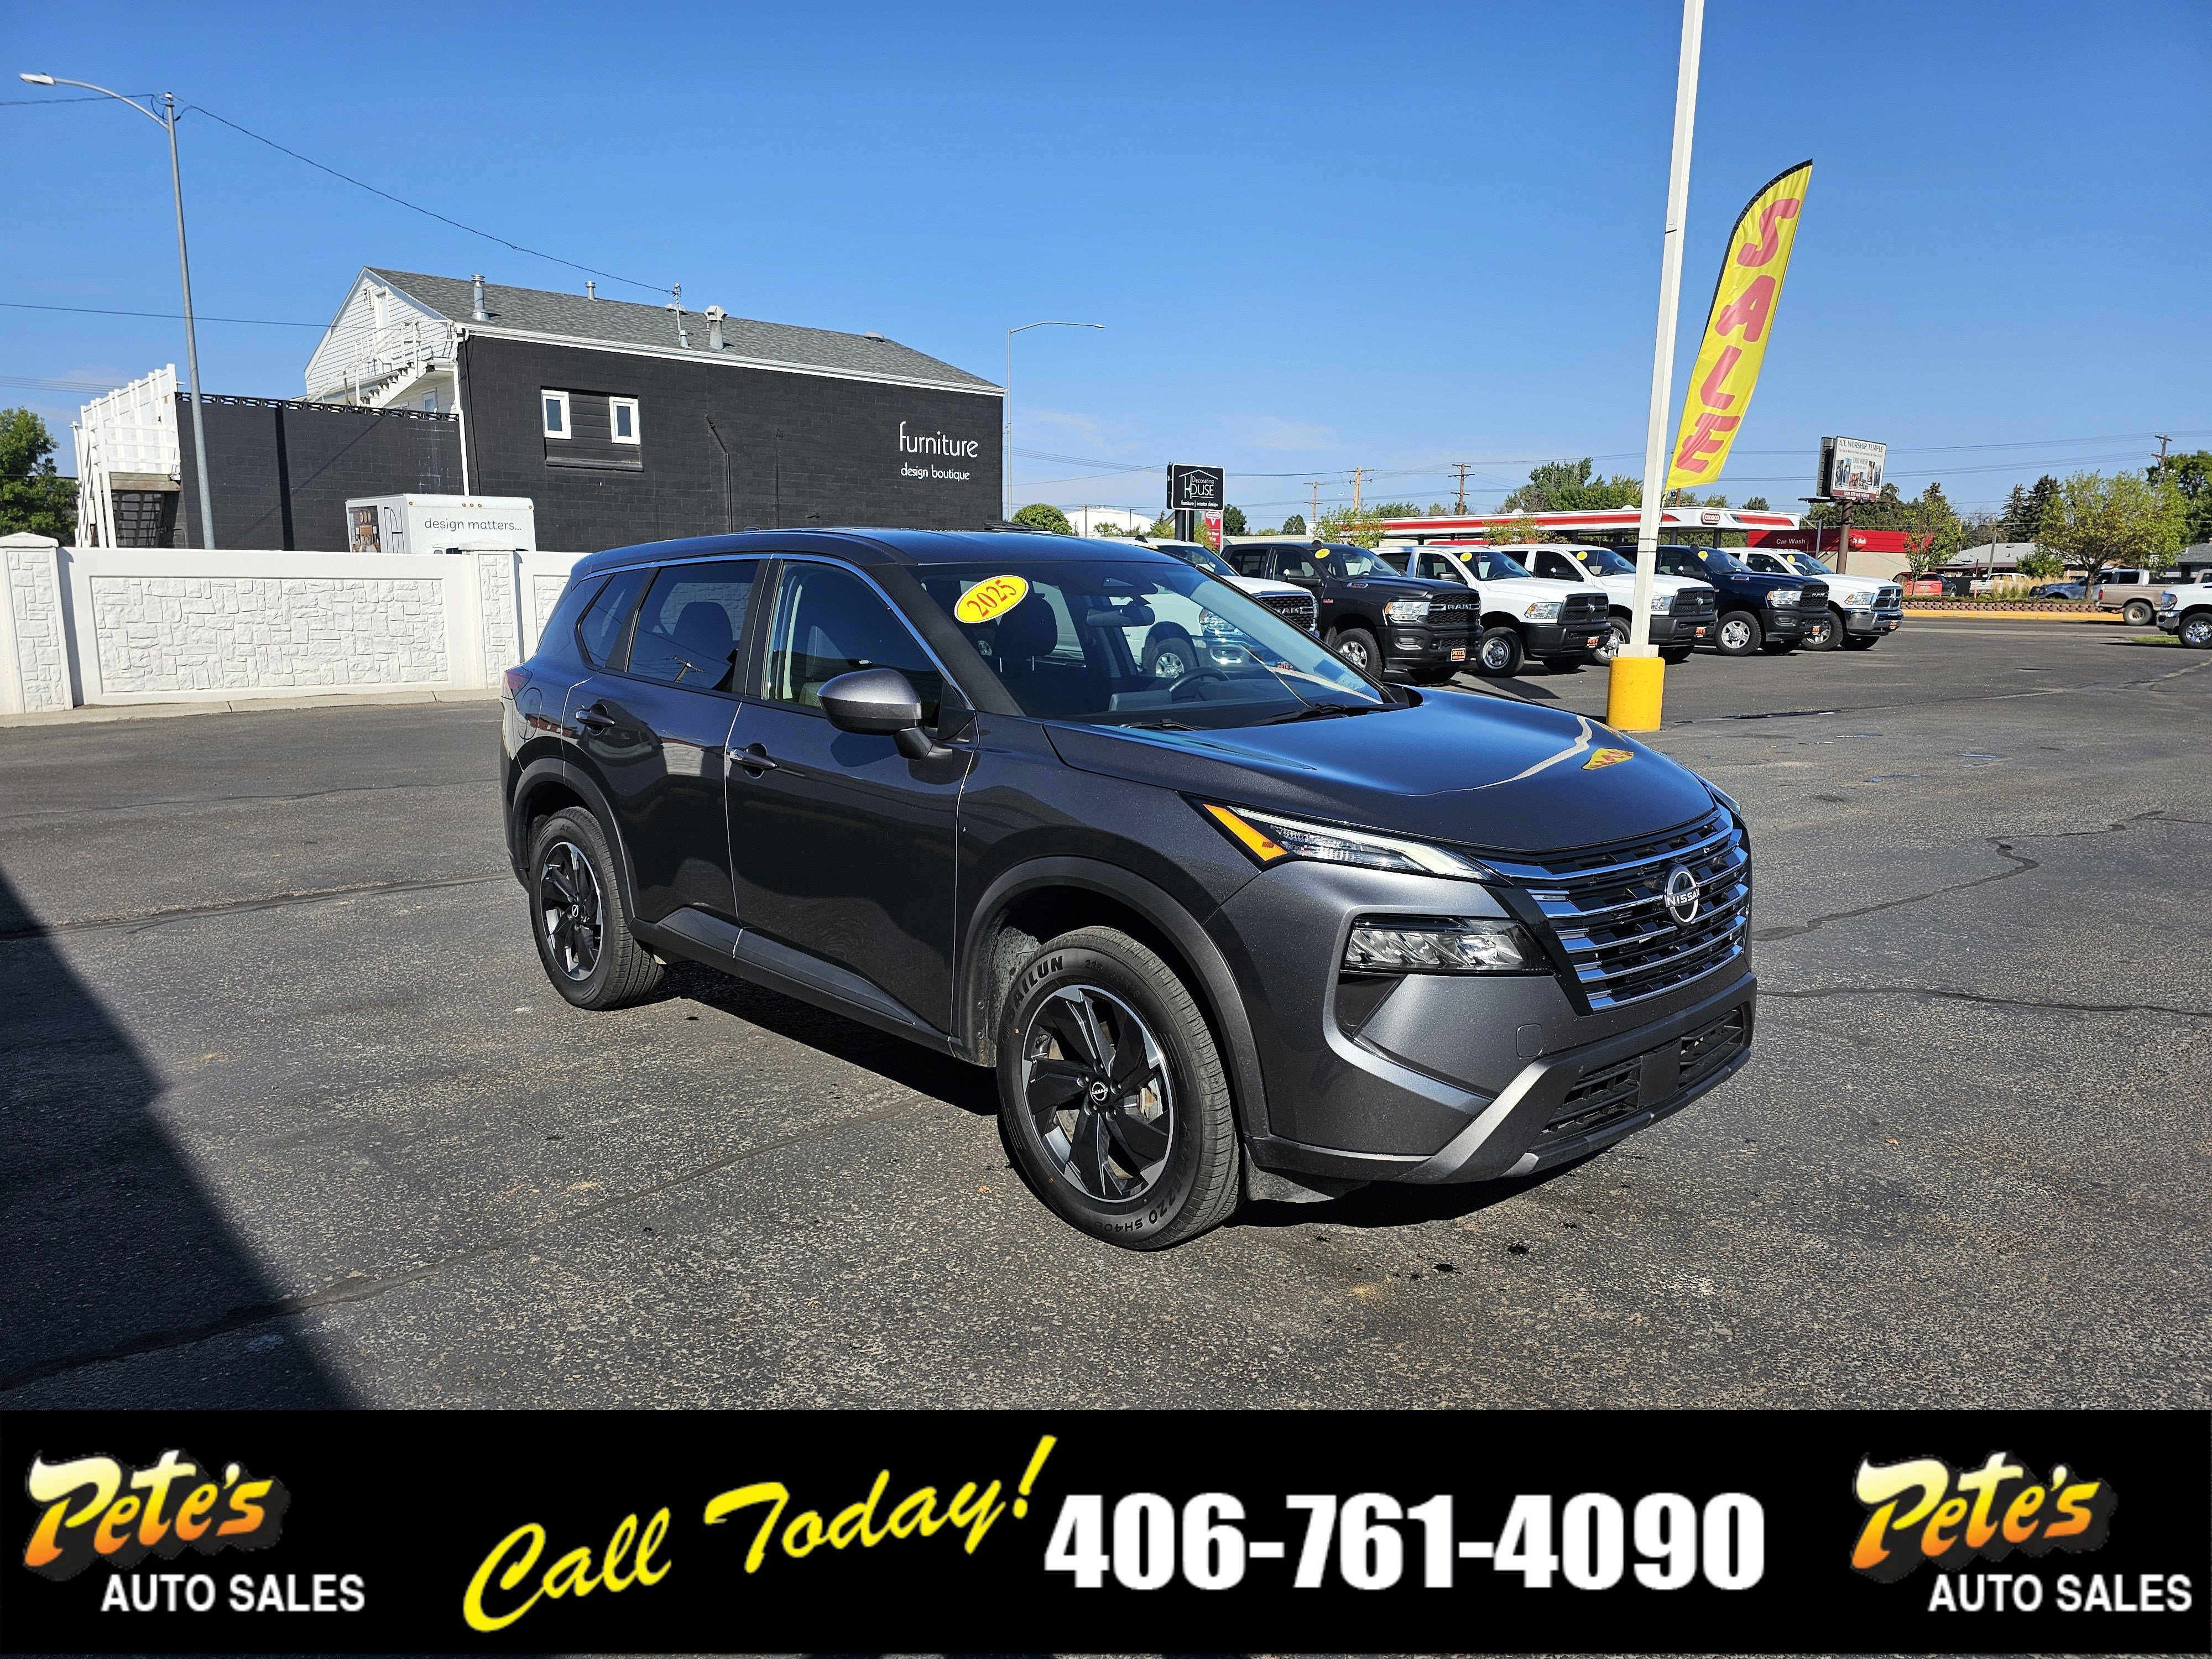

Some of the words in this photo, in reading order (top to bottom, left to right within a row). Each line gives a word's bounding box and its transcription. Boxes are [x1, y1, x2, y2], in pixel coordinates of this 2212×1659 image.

[1675, 197, 1799, 474] SALE
[900, 421, 979, 458] furniture
[1848, 441, 1867, 450] WORSHIP
[1868, 444, 1883, 452] TEMPLE
[900, 462, 928, 479] design
[931, 464, 971, 482] boutique
[1192, 476, 1214, 486] Decorating
[1184, 473, 1214, 499] HOUSE
[424, 518, 465, 532] design
[468, 519, 521, 531] matters...
[967, 580, 1016, 617] 2025
[1666, 886, 1700, 906] NISSAN
